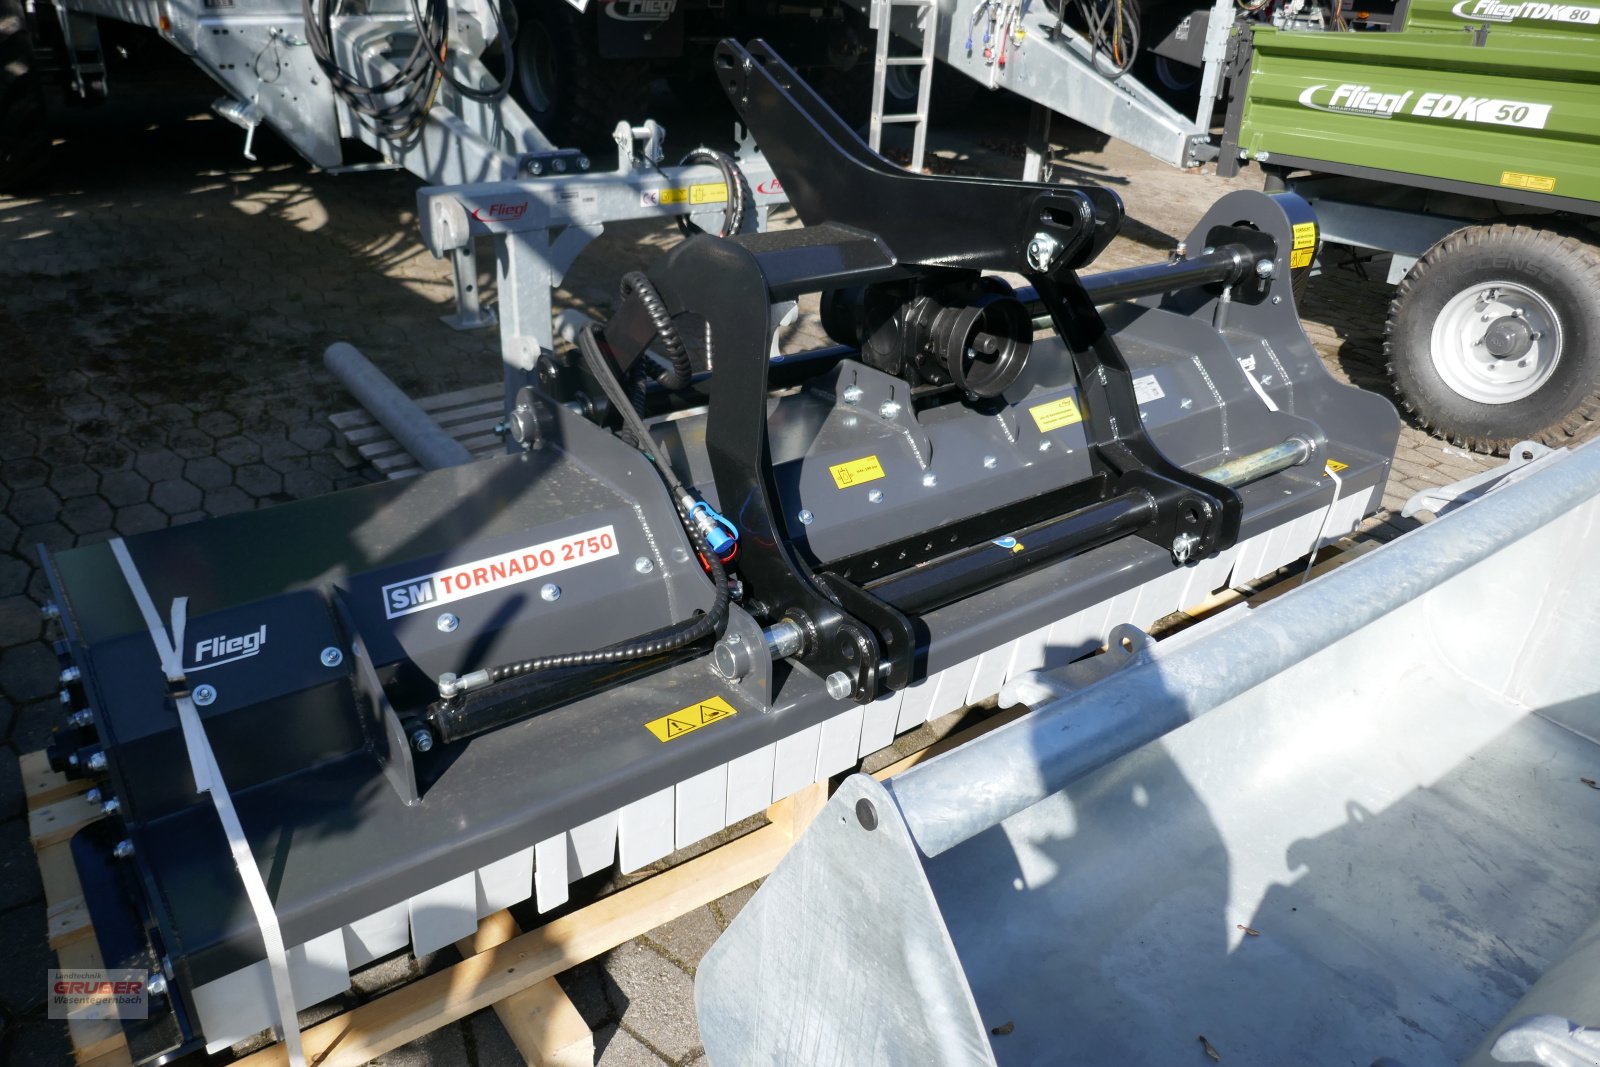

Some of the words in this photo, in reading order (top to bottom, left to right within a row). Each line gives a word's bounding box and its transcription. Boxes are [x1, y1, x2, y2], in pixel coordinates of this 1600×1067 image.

[1473, 0, 1527, 20] Fliegl
[1521, 3, 1566, 20] TDK
[1569, 9, 1590, 20] 80
[1328, 84, 1414, 115] Fliegl
[1411, 92, 1490, 121] EDK
[1495, 104, 1530, 123] 50
[488, 202, 528, 217] Fliegl
[390, 581, 434, 609] SM
[440, 550, 555, 594] TORNADO
[560, 533, 613, 561] 2750
[195, 624, 267, 662] Fliegl
